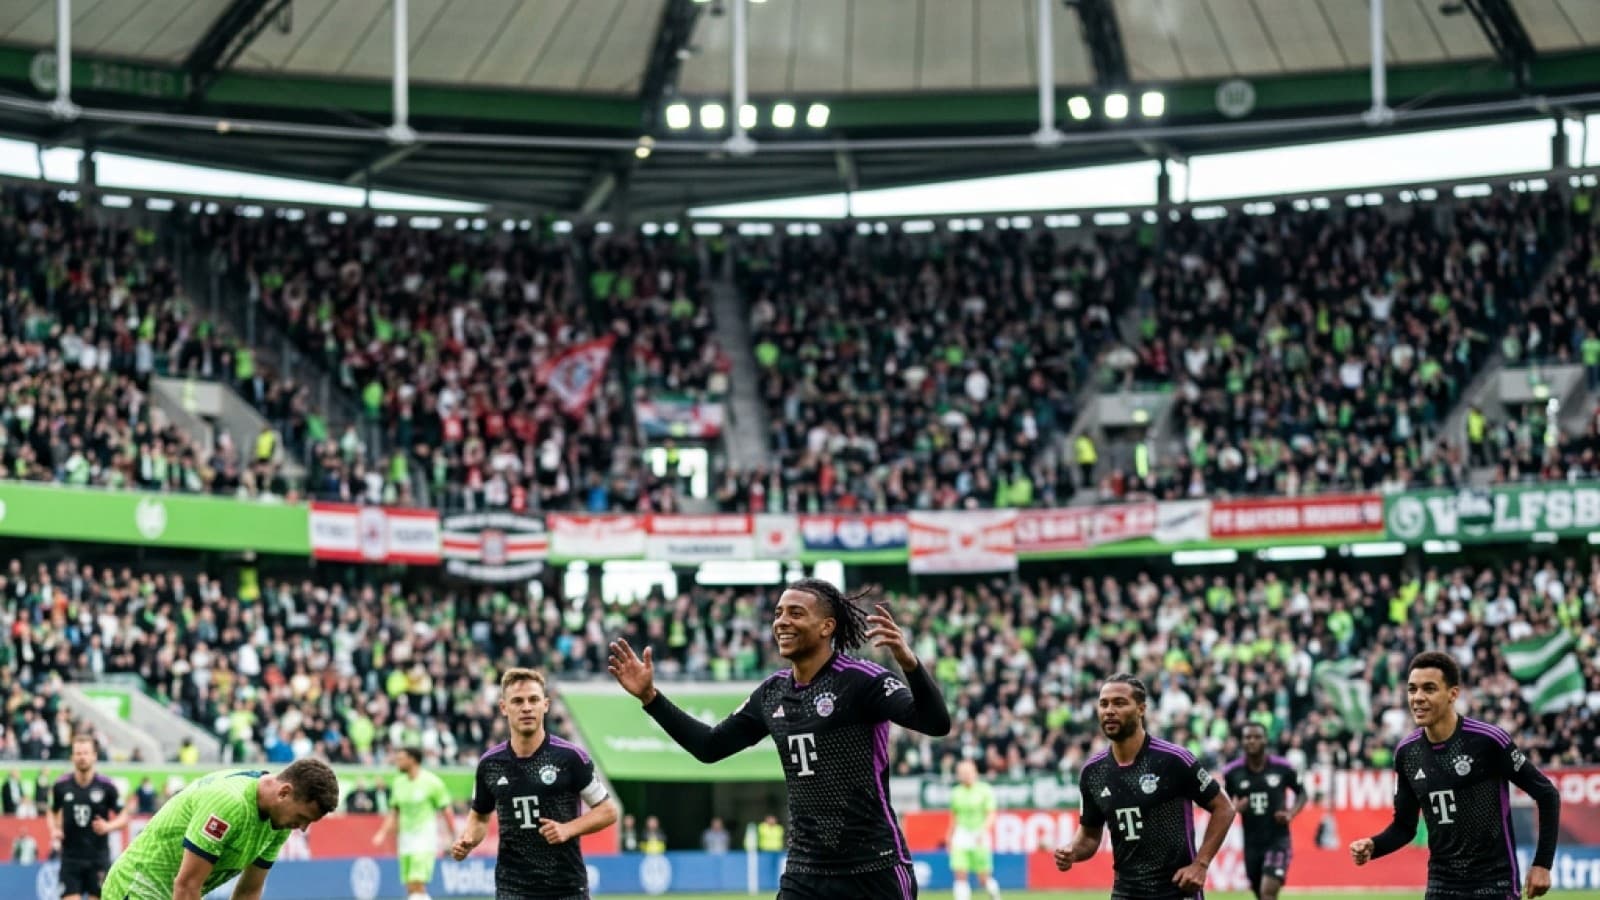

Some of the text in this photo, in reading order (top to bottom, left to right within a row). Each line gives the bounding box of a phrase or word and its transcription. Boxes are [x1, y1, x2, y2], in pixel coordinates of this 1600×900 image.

[787, 733, 818, 777] T
[512, 795, 540, 829] T
[1115, 807, 1143, 841] T
[1428, 789, 1457, 825] T
